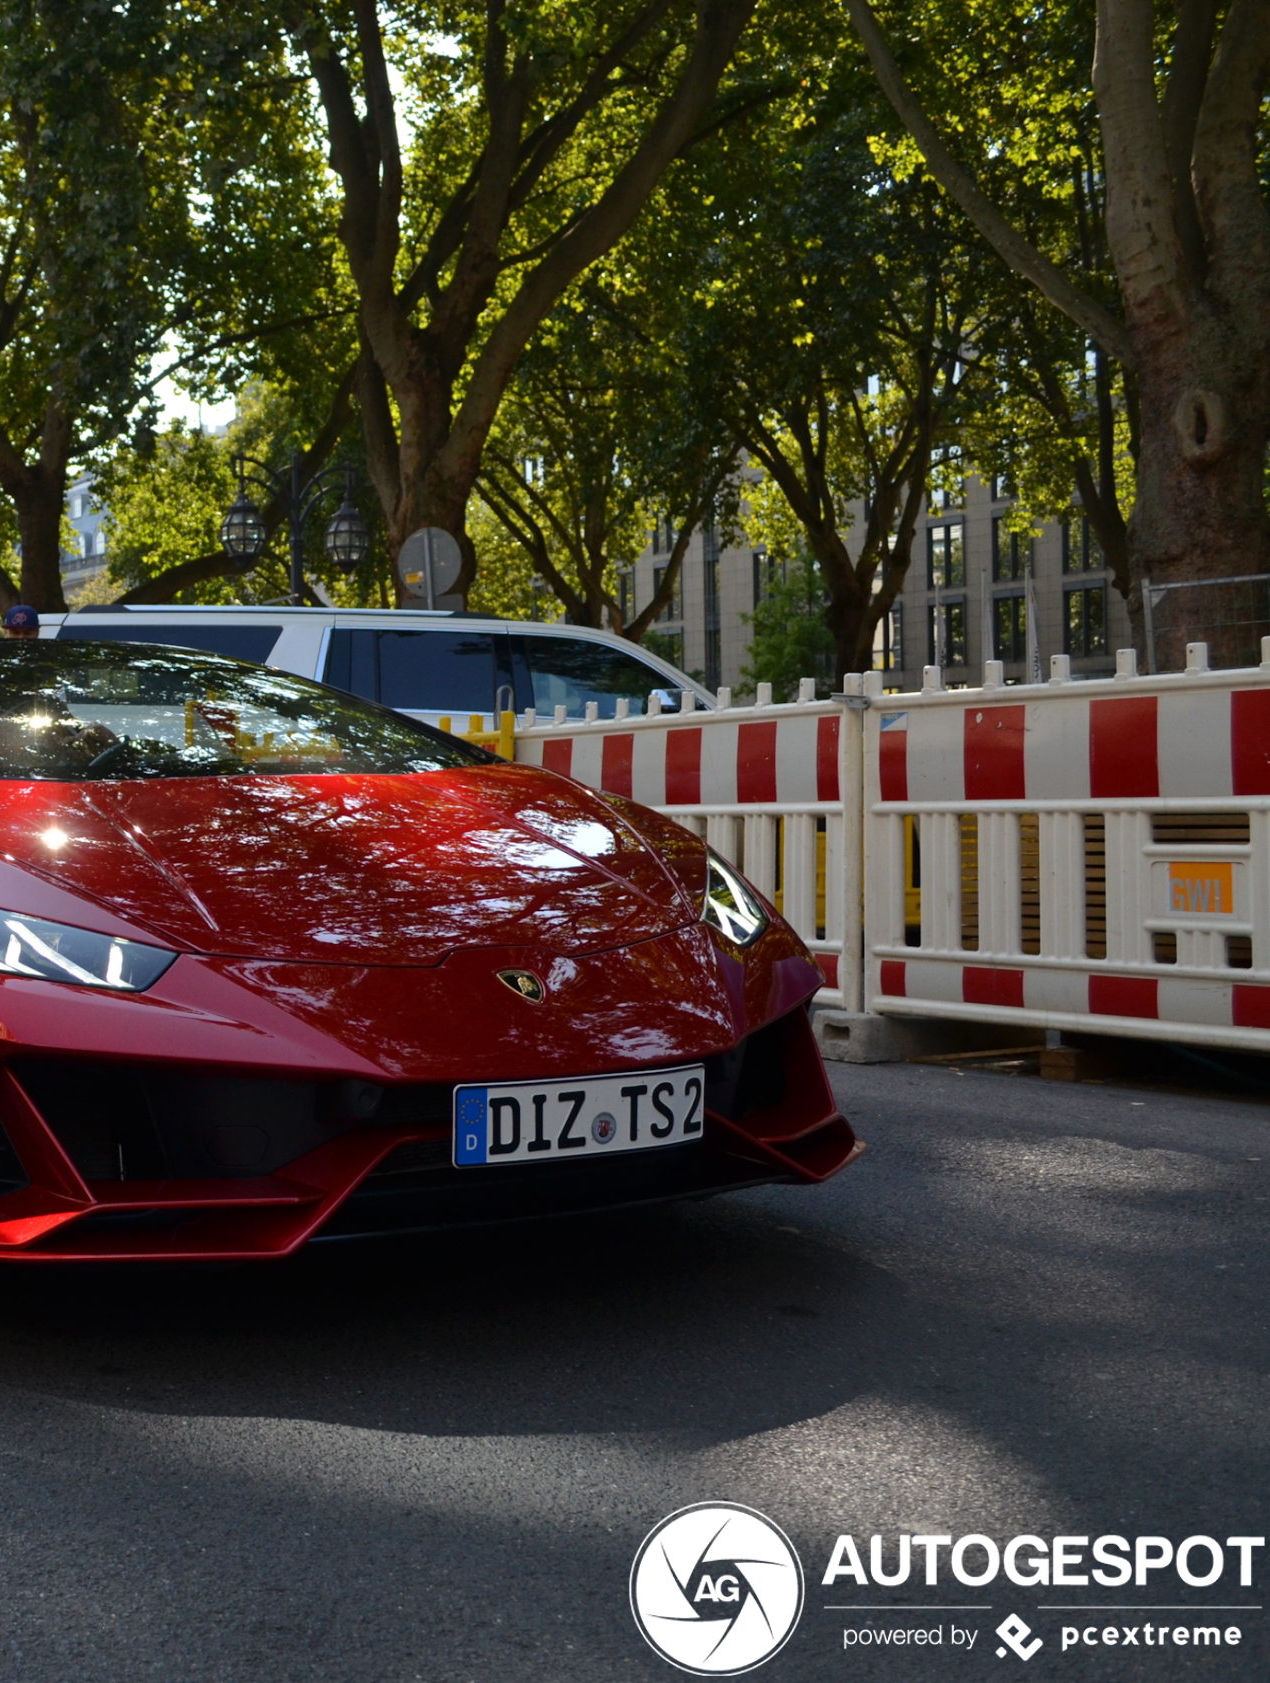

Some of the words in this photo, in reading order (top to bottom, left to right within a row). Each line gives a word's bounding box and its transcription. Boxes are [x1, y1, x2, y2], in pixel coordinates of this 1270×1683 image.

[488, 1090, 587, 1156] DIZ
[620, 1077, 702, 1142] TS2
[466, 1134, 478, 1150] D
